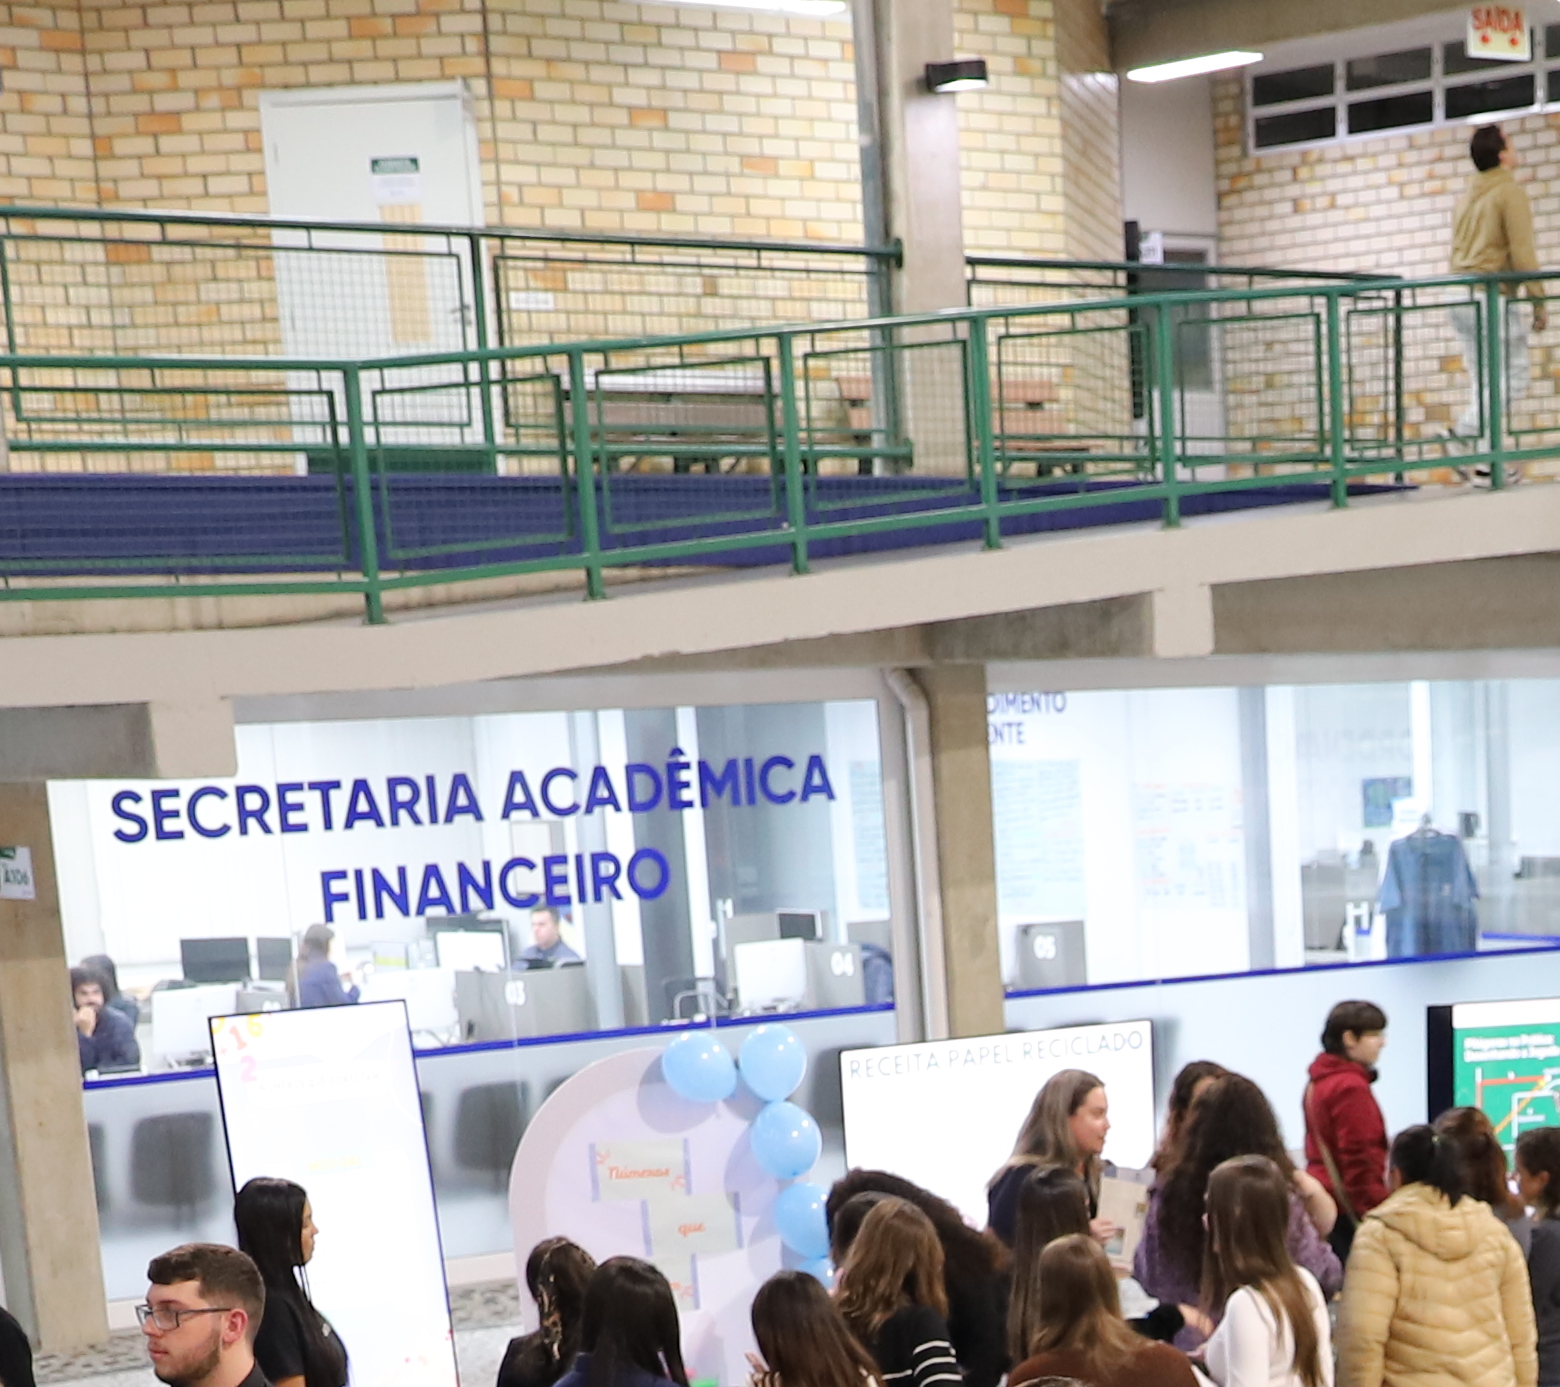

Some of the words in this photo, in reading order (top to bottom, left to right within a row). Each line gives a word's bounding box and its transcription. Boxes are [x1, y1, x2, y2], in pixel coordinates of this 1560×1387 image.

[1471, 5, 1524, 33] SAÍDA
[111, 773, 484, 843] SECRETARIA
[501, 747, 836, 820] ACADÊMICA
[321, 847, 670, 923] FINANCEIRO
[830, 951, 854, 976] 04
[850, 1052, 939, 1078] RECEITA
[949, 1044, 1013, 1068] PAPEL
[1023, 1030, 1143, 1060] RECICLADO
[678, 1222, 705, 1237] que
